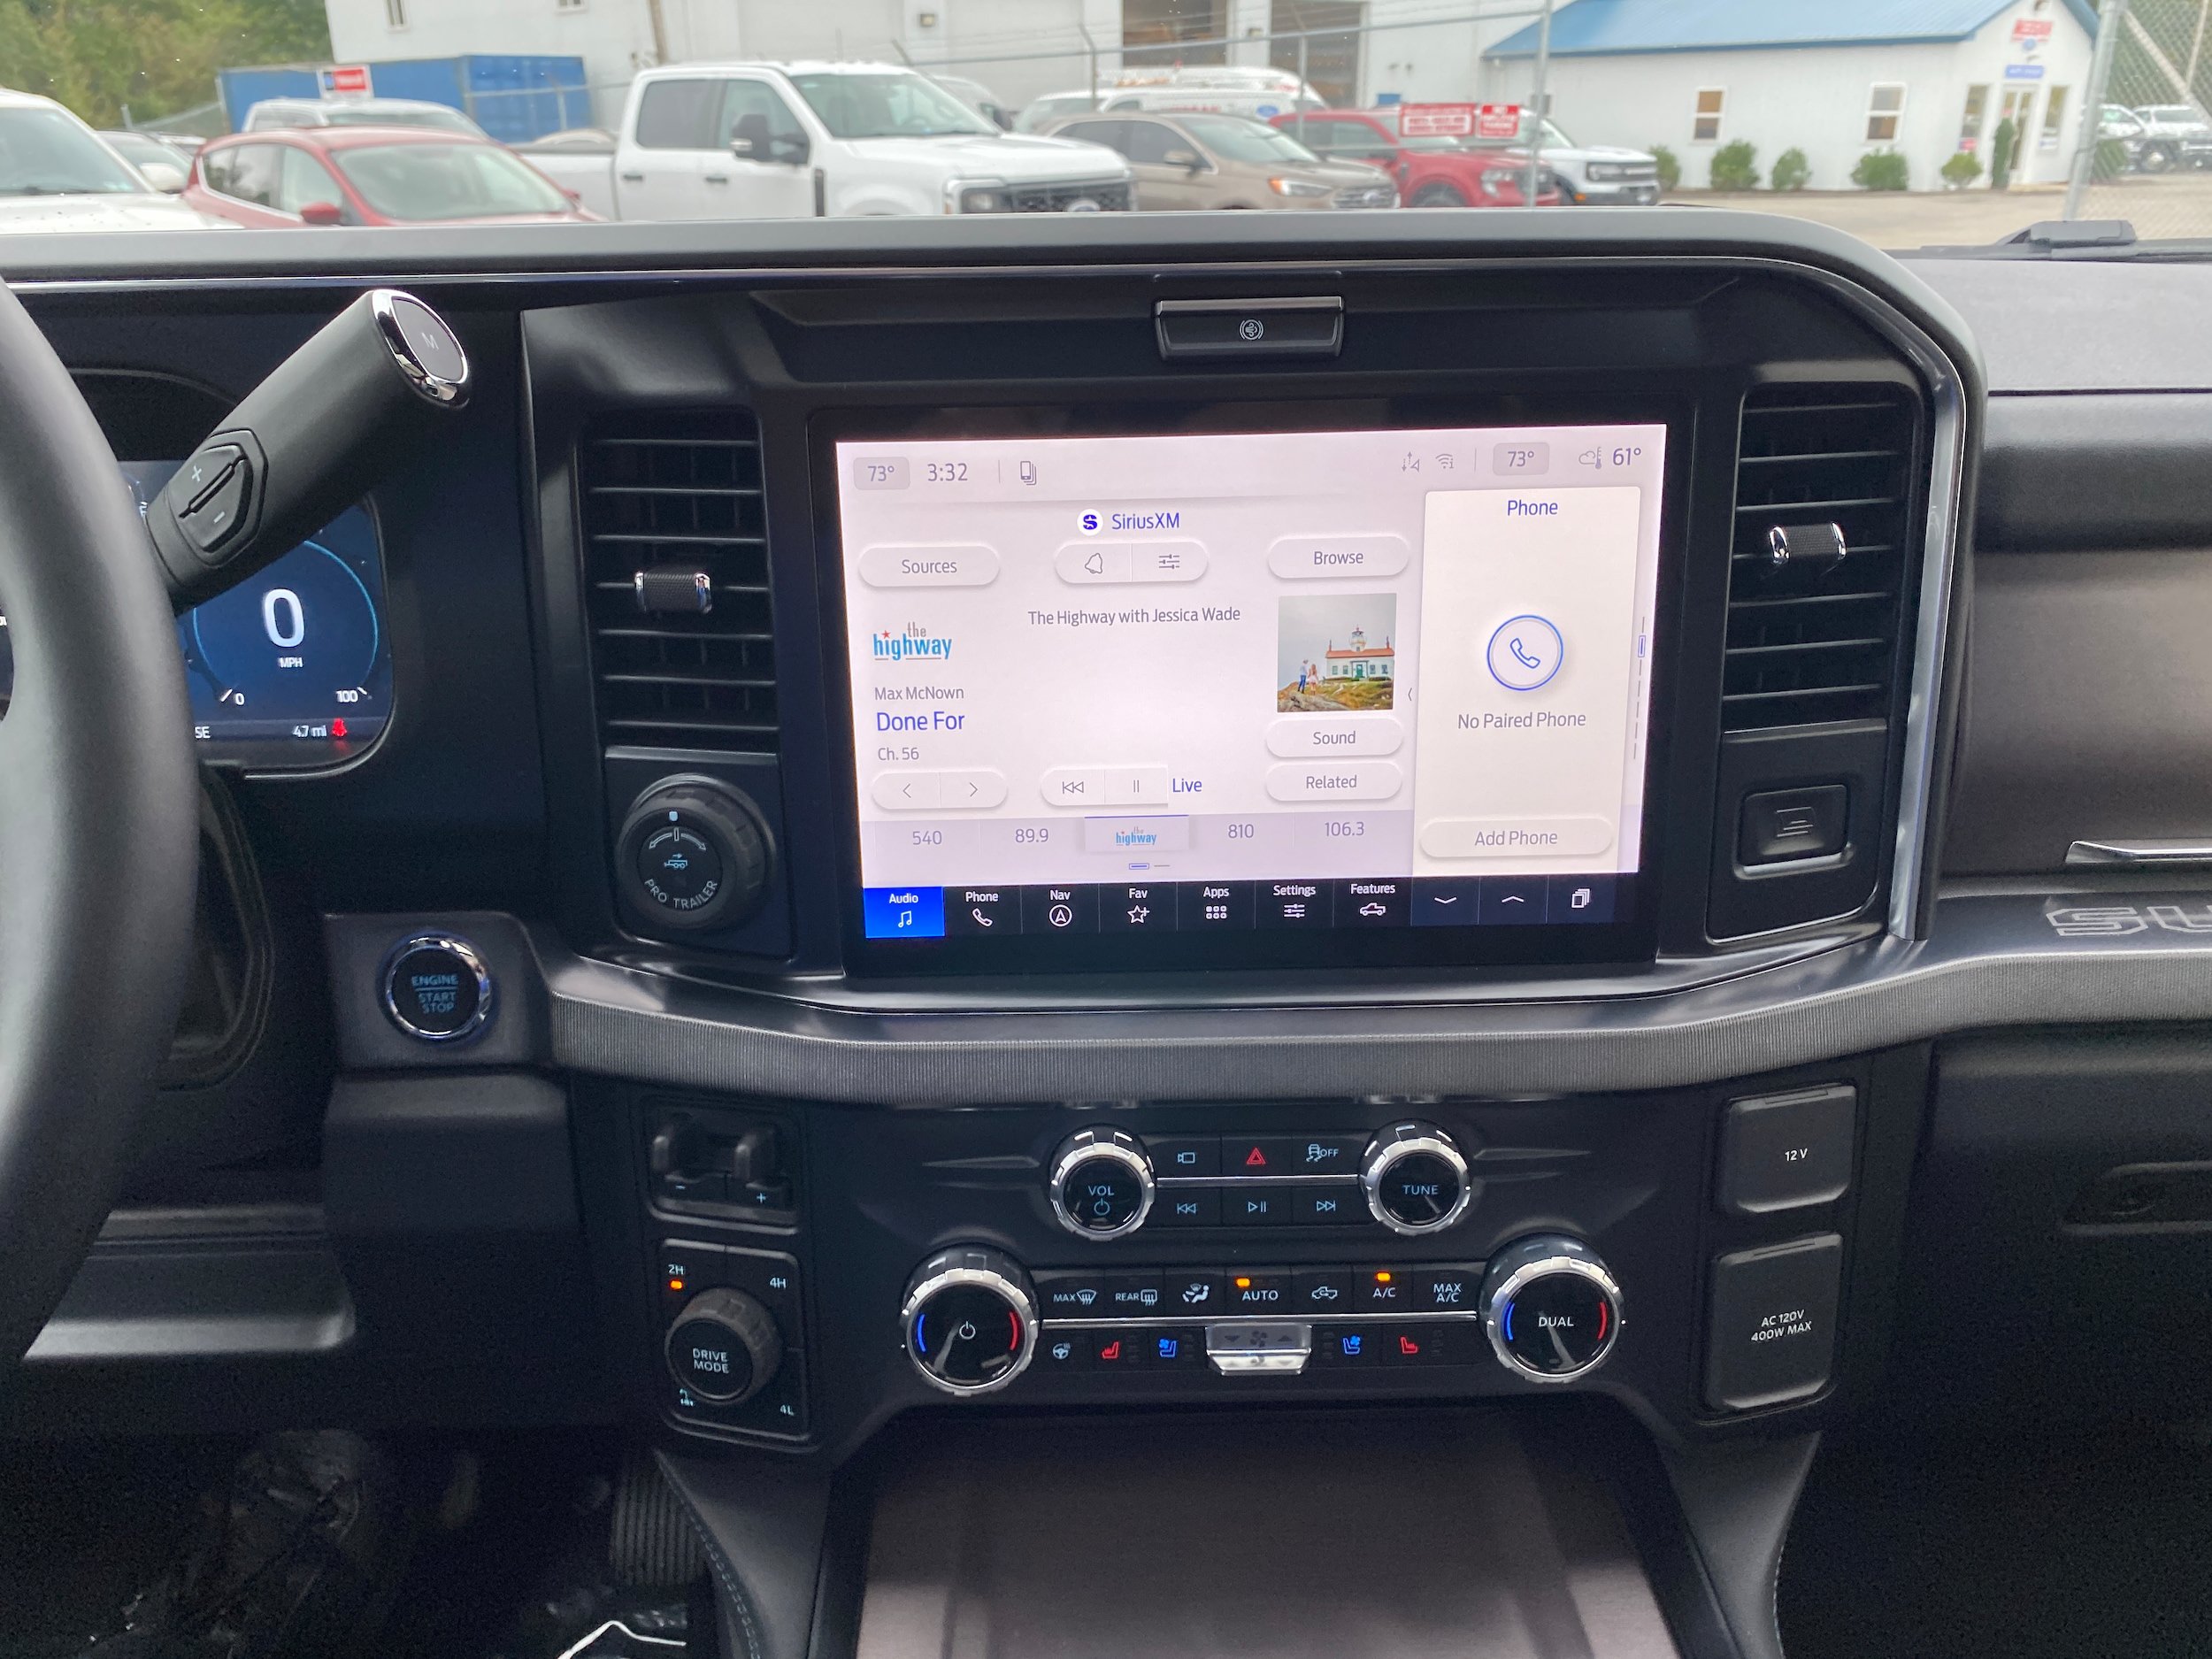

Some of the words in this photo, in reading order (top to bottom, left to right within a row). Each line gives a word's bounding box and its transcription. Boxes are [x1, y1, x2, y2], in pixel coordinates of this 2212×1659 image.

[421, 332, 440, 351] M
[1507, 450, 1535, 468] 73°
[1612, 447, 1642, 466] 61°
[867, 465, 895, 483] 73°
[927, 463, 968, 483] 3:32
[1507, 500, 1558, 517] Phone
[1111, 512, 1179, 531] SiriusXM
[1313, 550, 1363, 565] Browse
[902, 558, 957, 575] Sources
[264, 588, 306, 648] 0
[1028, 611, 1054, 626] The
[1056, 610, 1116, 626] Highway
[1118, 608, 1149, 625] with
[1152, 608, 1199, 624] Jessica
[1202, 606, 1241, 622] Wade
[907, 621, 927, 638] the
[872, 631, 953, 660] highway
[278, 657, 303, 668] MPH
[234, 693, 245, 706] 0
[336, 690, 359, 703] 100
[874, 687, 902, 701] Max
[906, 686, 964, 700] McNown
[877, 712, 928, 732] Done
[933, 711, 965, 731] For
[1458, 713, 1479, 729] No
[1484, 712, 1532, 729] Paired
[1537, 710, 1586, 727] Phone
[311, 725, 327, 738] mi
[1313, 731, 1356, 747] Sound
[878, 747, 899, 761] Ch.
[902, 747, 919, 761] 56
[1172, 778, 1203, 794] Live
[1305, 774, 1357, 790] Related
[1015, 828, 1049, 844] 89.9
[1227, 823, 1255, 840] 810
[1325, 821, 1364, 837] 106.3
[912, 830, 942, 846] 540
[1115, 831, 1158, 846] highway
[1474, 831, 1505, 847] Add
[1509, 830, 1558, 846] Phone
[644, 878, 668, 903] PRO
[672, 879, 718, 910] TRAILER
[965, 890, 999, 902] Phone
[1049, 889, 1071, 901] Nav
[1129, 887, 1148, 900] Fav
[1203, 886, 1229, 900] Apps
[1273, 883, 1317, 897] Settings
[1350, 882, 1396, 895] Features
[888, 892, 918, 904] Audio
[411, 974, 458, 987] ENGINE
[418, 990, 456, 1003] START
[422, 1002, 455, 1015] STOP
[1319, 1147, 1339, 1158] OFF
[1785, 1149, 1798, 1162] 12
[1798, 1148, 1808, 1159] V
[1087, 1185, 1115, 1197] VOL
[1402, 1183, 1440, 1196] TUNE
[668, 1263, 685, 1276] 2H
[769, 1277, 787, 1290] 4H
[1432, 1282, 1462, 1294] MAX
[1053, 1292, 1076, 1302] MAX
[1115, 1292, 1141, 1302] REAR
[1241, 1289, 1279, 1302] AUTO
[1372, 1286, 1396, 1299] A/C
[1436, 1291, 1460, 1303] A/C
[1538, 1315, 1575, 1328] DUAL
[1761, 1314, 1778, 1327] AC
[1778, 1309, 1805, 1325] 120V
[1751, 1325, 1785, 1342] 400W
[1787, 1320, 1812, 1337] MAX
[692, 1348, 729, 1363] DRIVE
[693, 1359, 730, 1375] MODE
[780, 1403, 795, 1417] 4L
